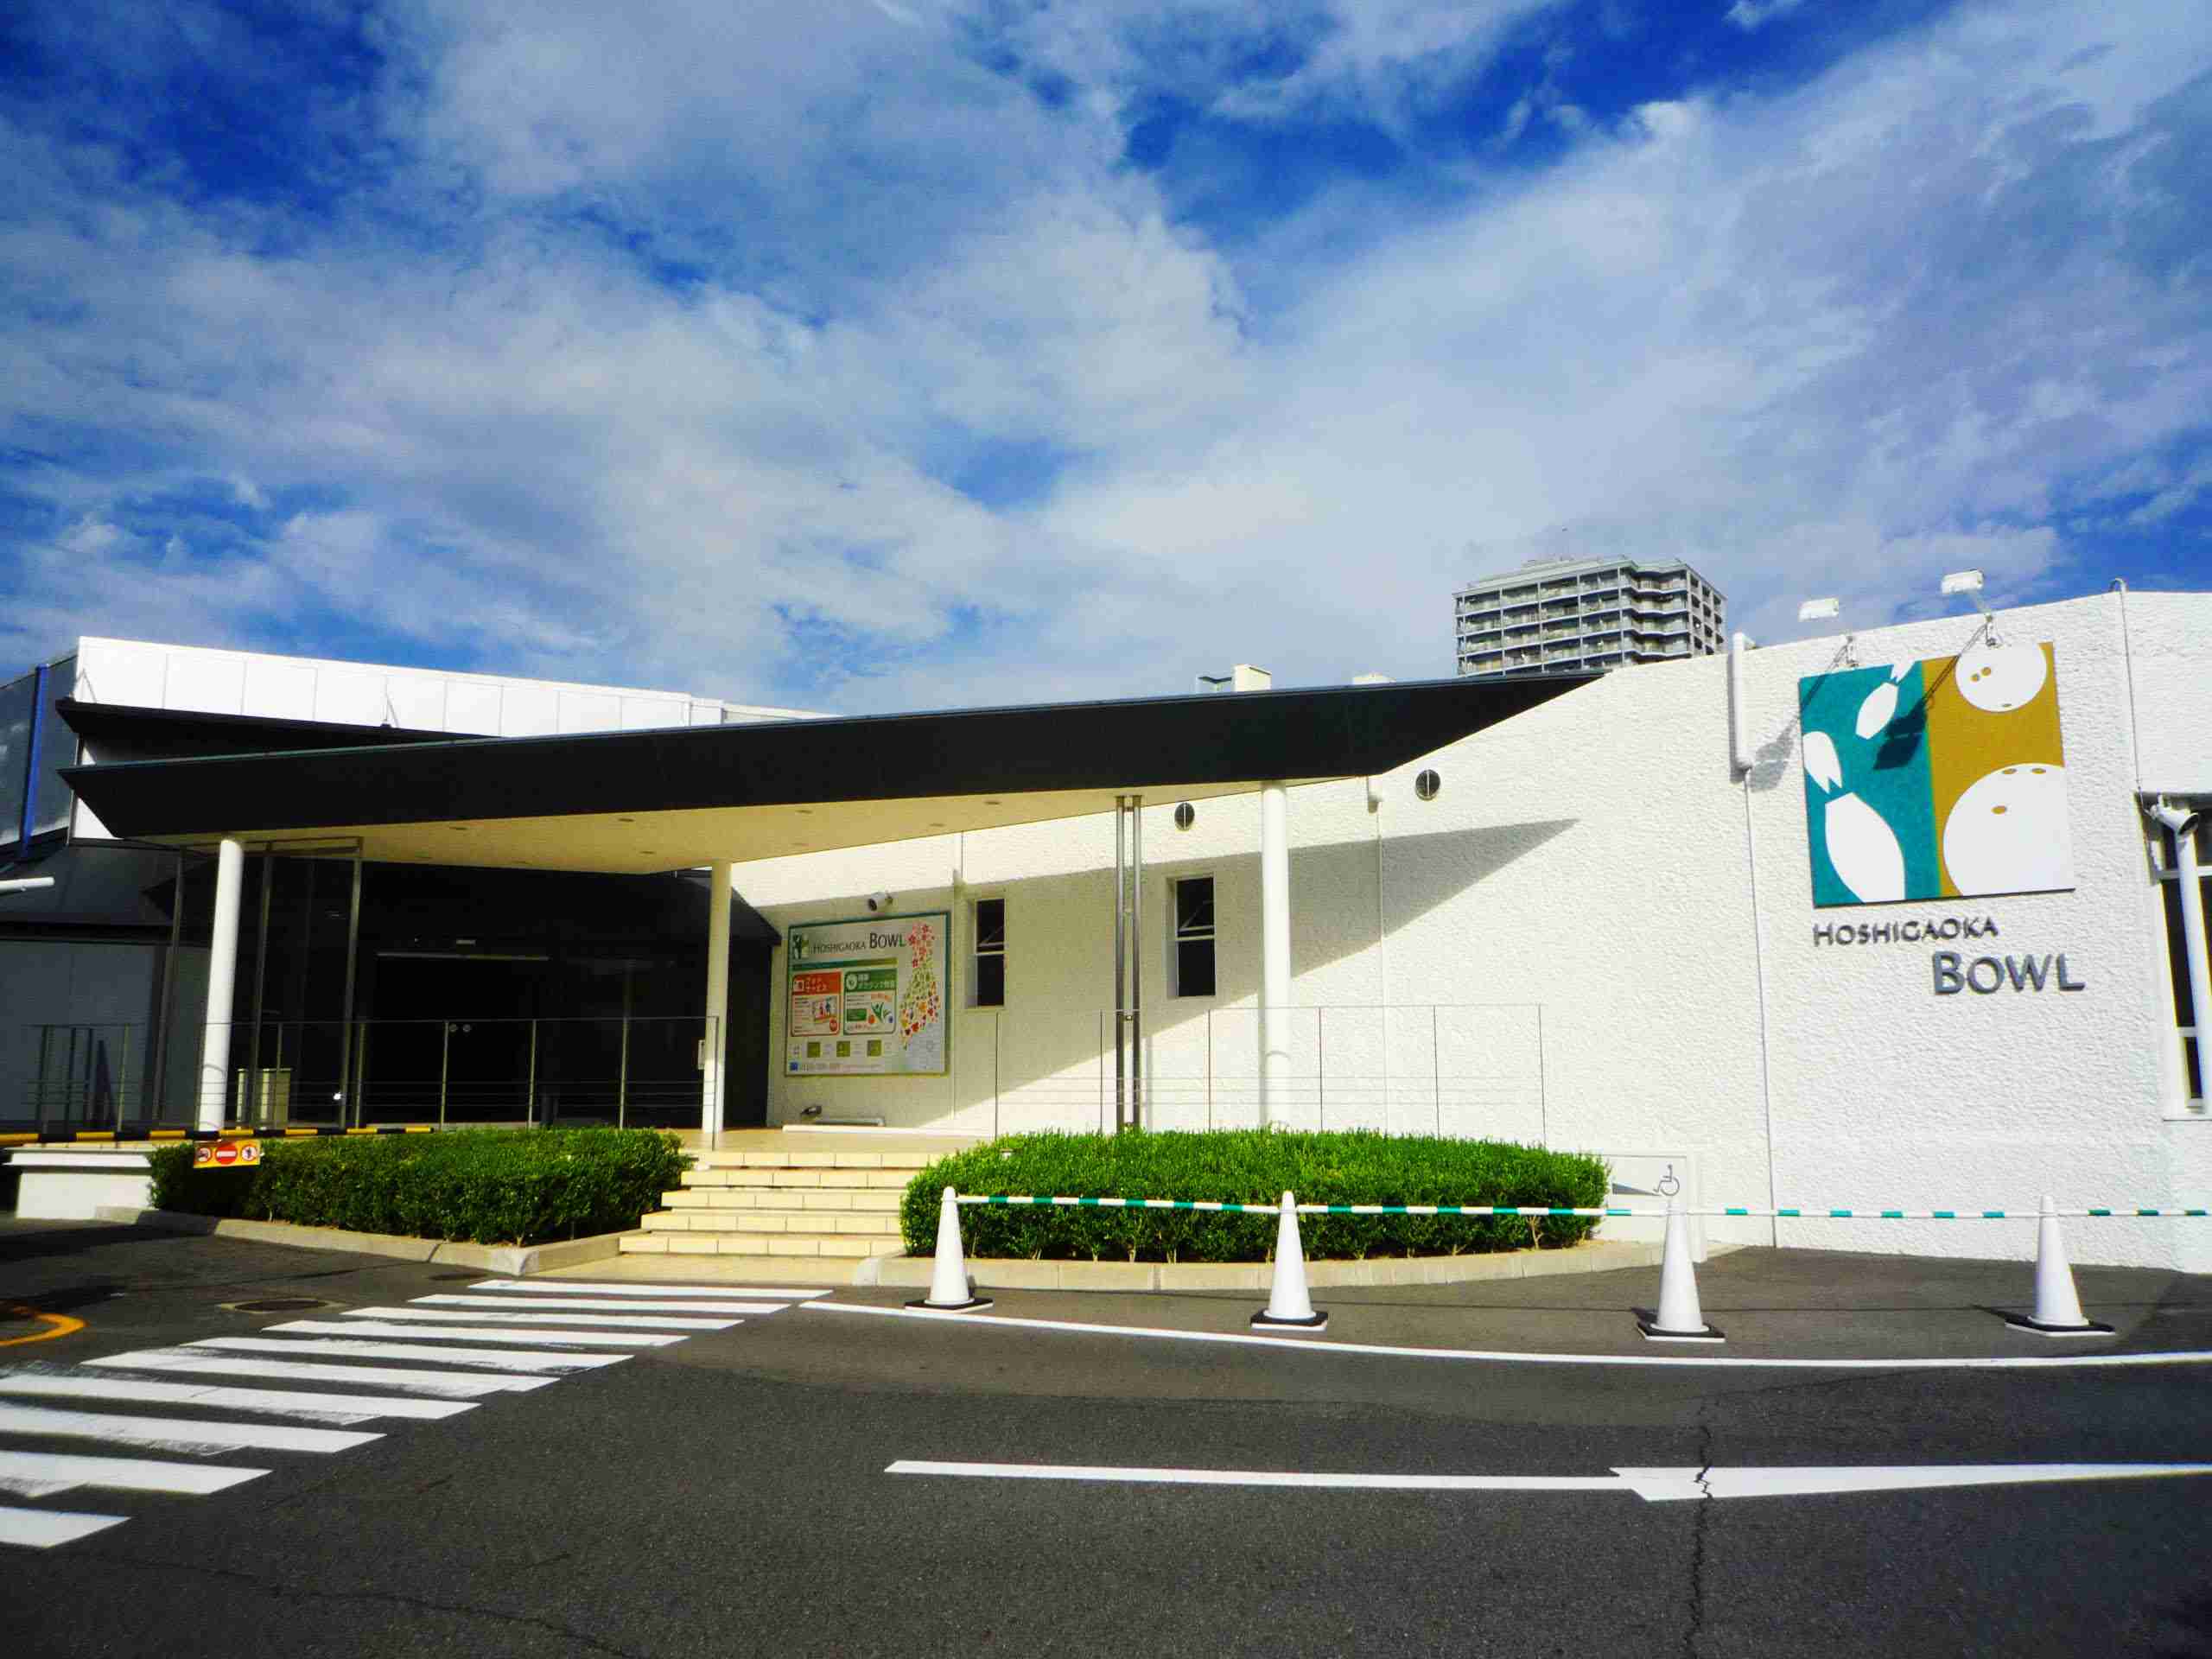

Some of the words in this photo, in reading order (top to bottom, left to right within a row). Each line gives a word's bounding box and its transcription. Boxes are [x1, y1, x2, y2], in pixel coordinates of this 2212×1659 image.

[869, 932, 906, 949] BOWL
[1813, 917, 1999, 946] HOSHIGAOKA
[1934, 951, 2085, 995] BOWL
